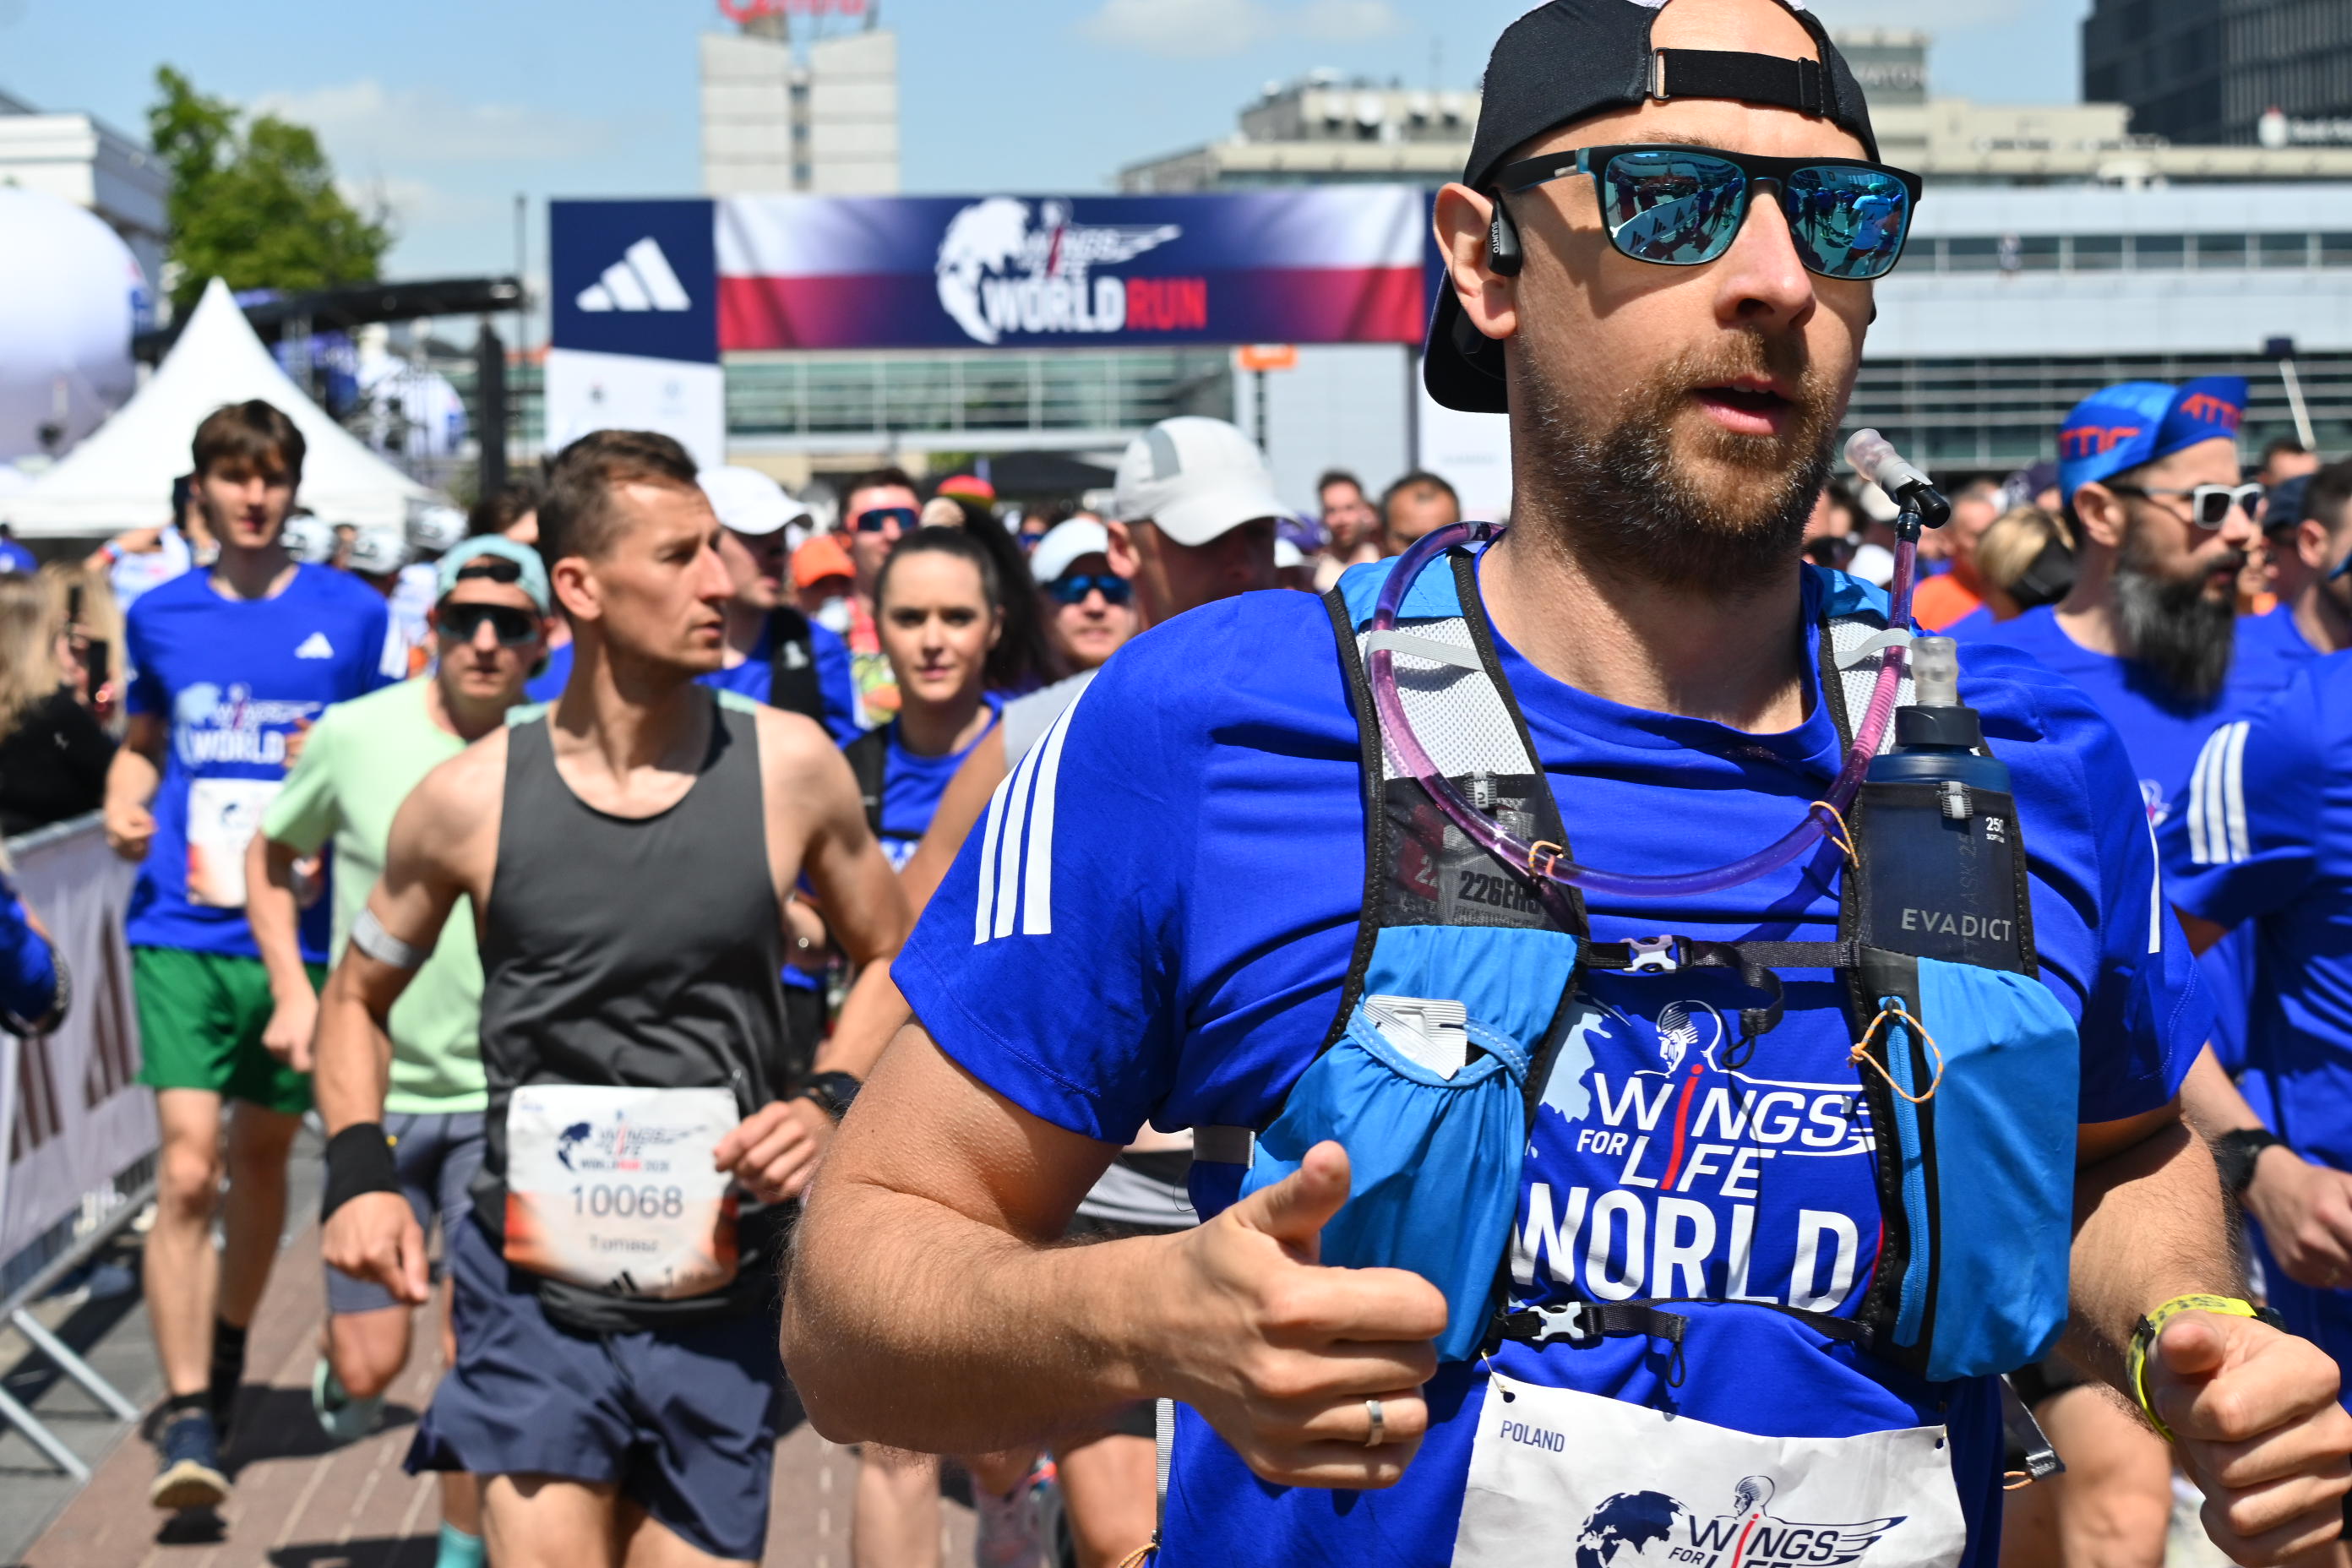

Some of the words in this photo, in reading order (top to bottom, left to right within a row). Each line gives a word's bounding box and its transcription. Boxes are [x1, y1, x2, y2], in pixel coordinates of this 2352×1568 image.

[1491, 221, 1500, 253] SUUNTO
[1901, 907, 2012, 942] EVADICT
[1576, 1128, 1629, 1156] FOR
[571, 1183, 684, 1219] 10068
[1509, 1182, 1859, 1313] WORLD
[1500, 1419, 1565, 1452] POLAND
[1669, 1546, 1706, 1565] FOR
